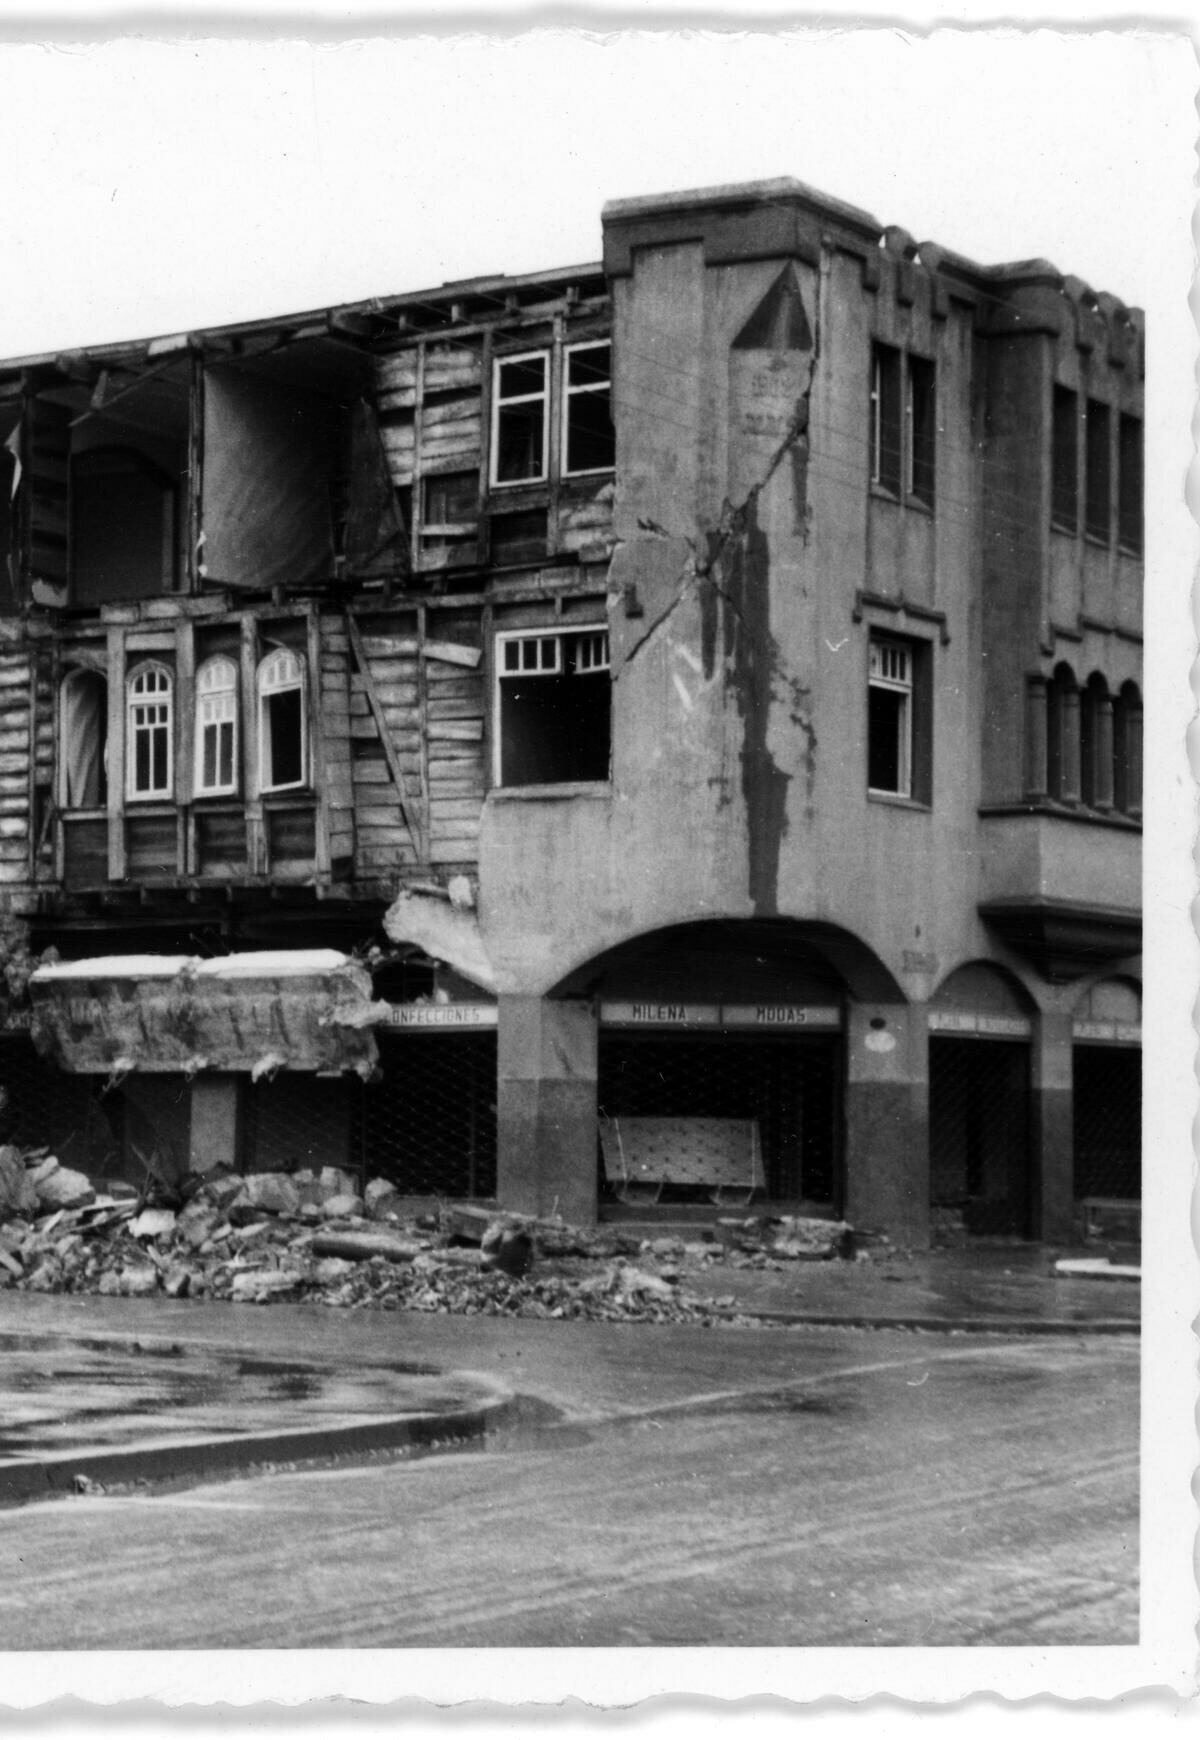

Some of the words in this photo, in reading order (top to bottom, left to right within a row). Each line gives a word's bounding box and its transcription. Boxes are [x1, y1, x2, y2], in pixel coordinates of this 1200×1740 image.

[390, 1007, 480, 1023] ONFECCIONES
[632, 1005, 687, 1021] MILENA
[755, 1007, 807, 1023] MODAS
